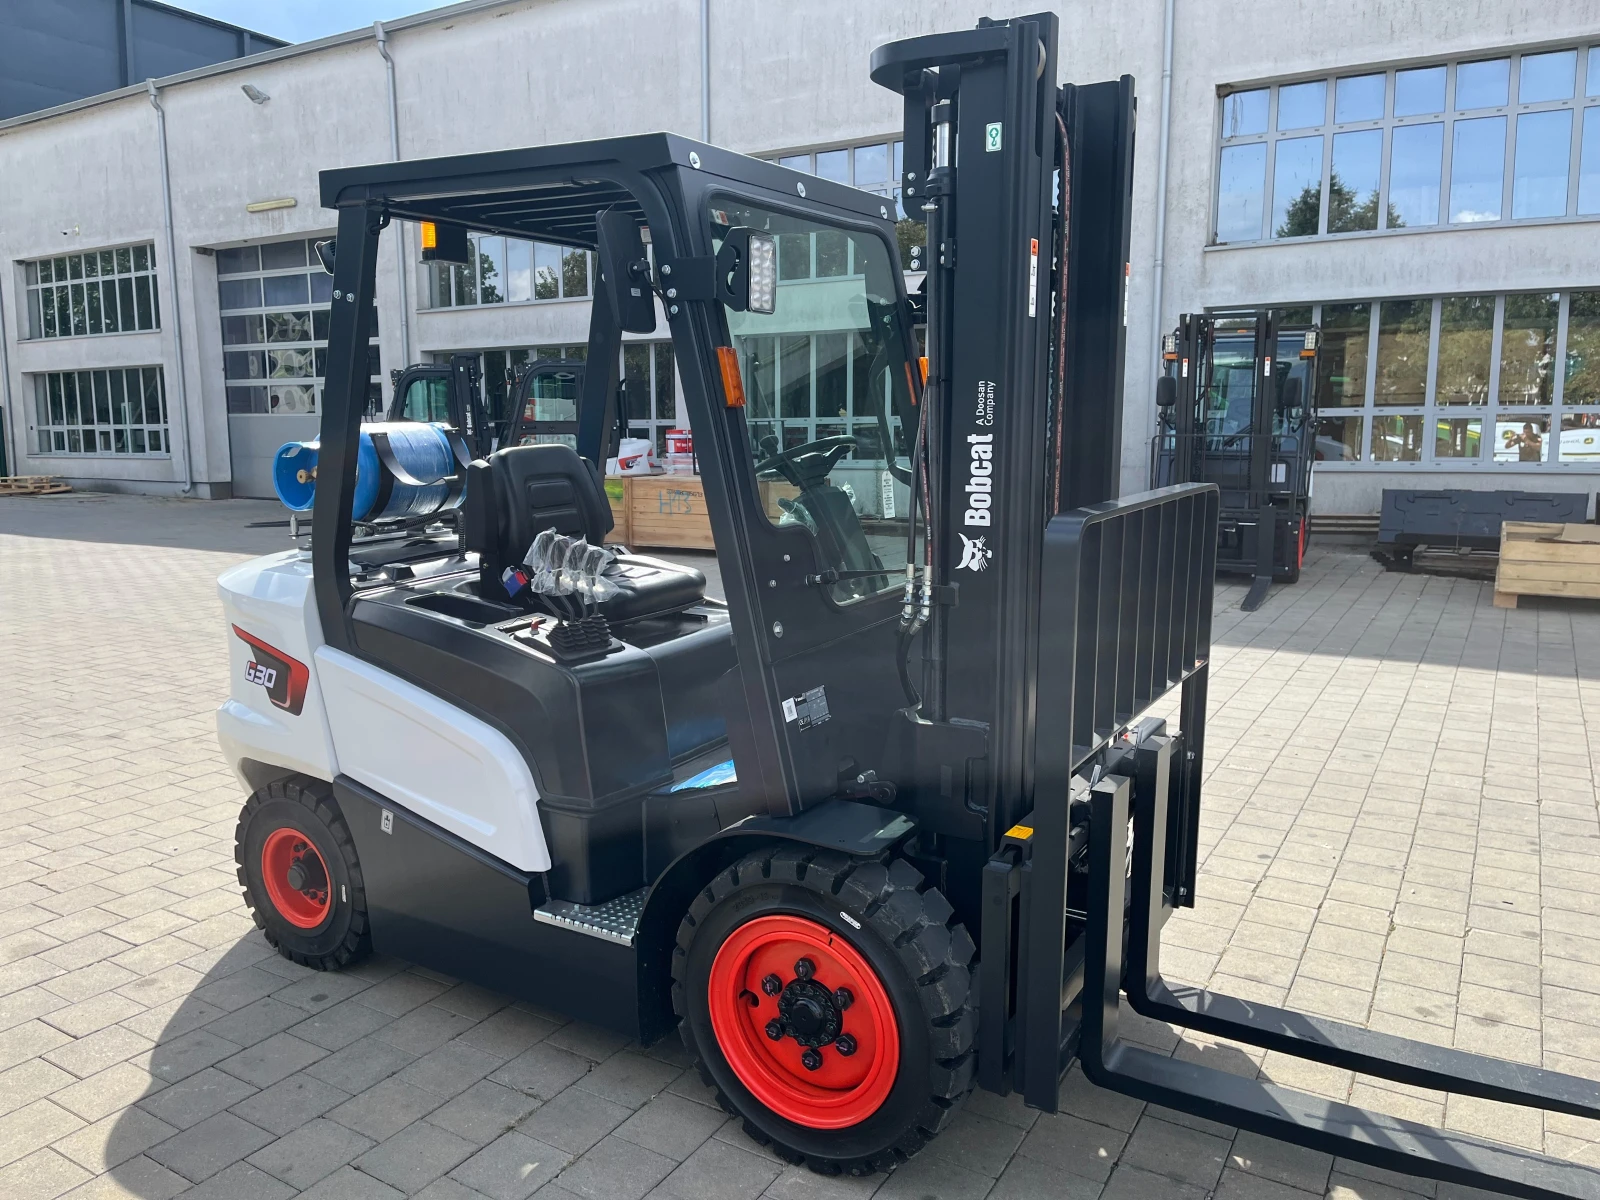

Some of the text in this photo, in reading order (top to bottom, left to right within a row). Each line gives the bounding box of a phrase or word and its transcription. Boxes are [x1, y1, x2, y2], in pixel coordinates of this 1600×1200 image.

[975, 380, 985, 426] A Doosan
[984, 380, 997, 426] Company
[964, 433, 994, 527] Bobcat
[245, 660, 278, 689] G30
